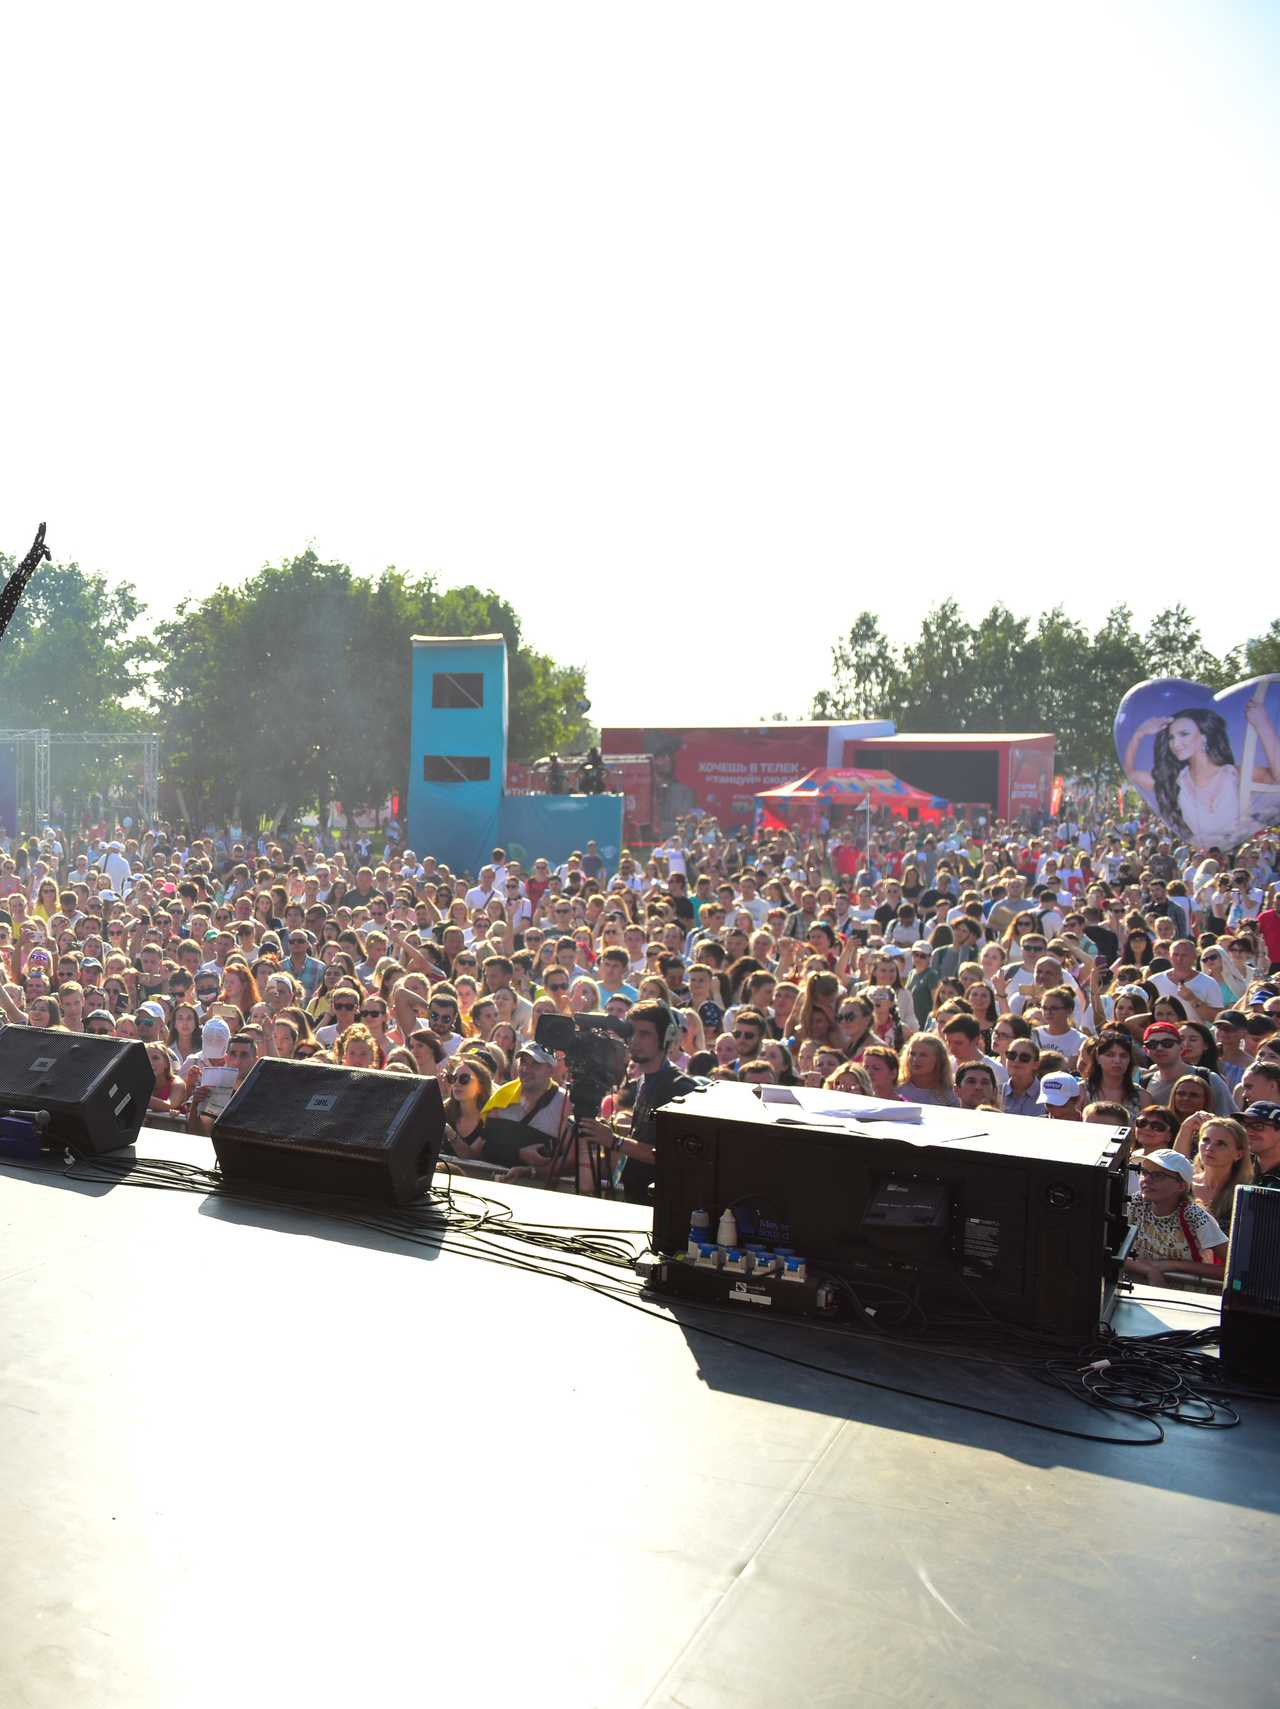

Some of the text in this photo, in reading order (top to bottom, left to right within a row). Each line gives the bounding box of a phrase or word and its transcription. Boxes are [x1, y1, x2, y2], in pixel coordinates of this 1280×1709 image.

[698, 762, 747, 772] ХОЧЕШЬ
[749, 762, 758, 772] В
[760, 762, 799, 773] ТЕЛЕК
[705, 774, 761, 786] «танцуй»
[313, 1098, 329, 1107] JBL
